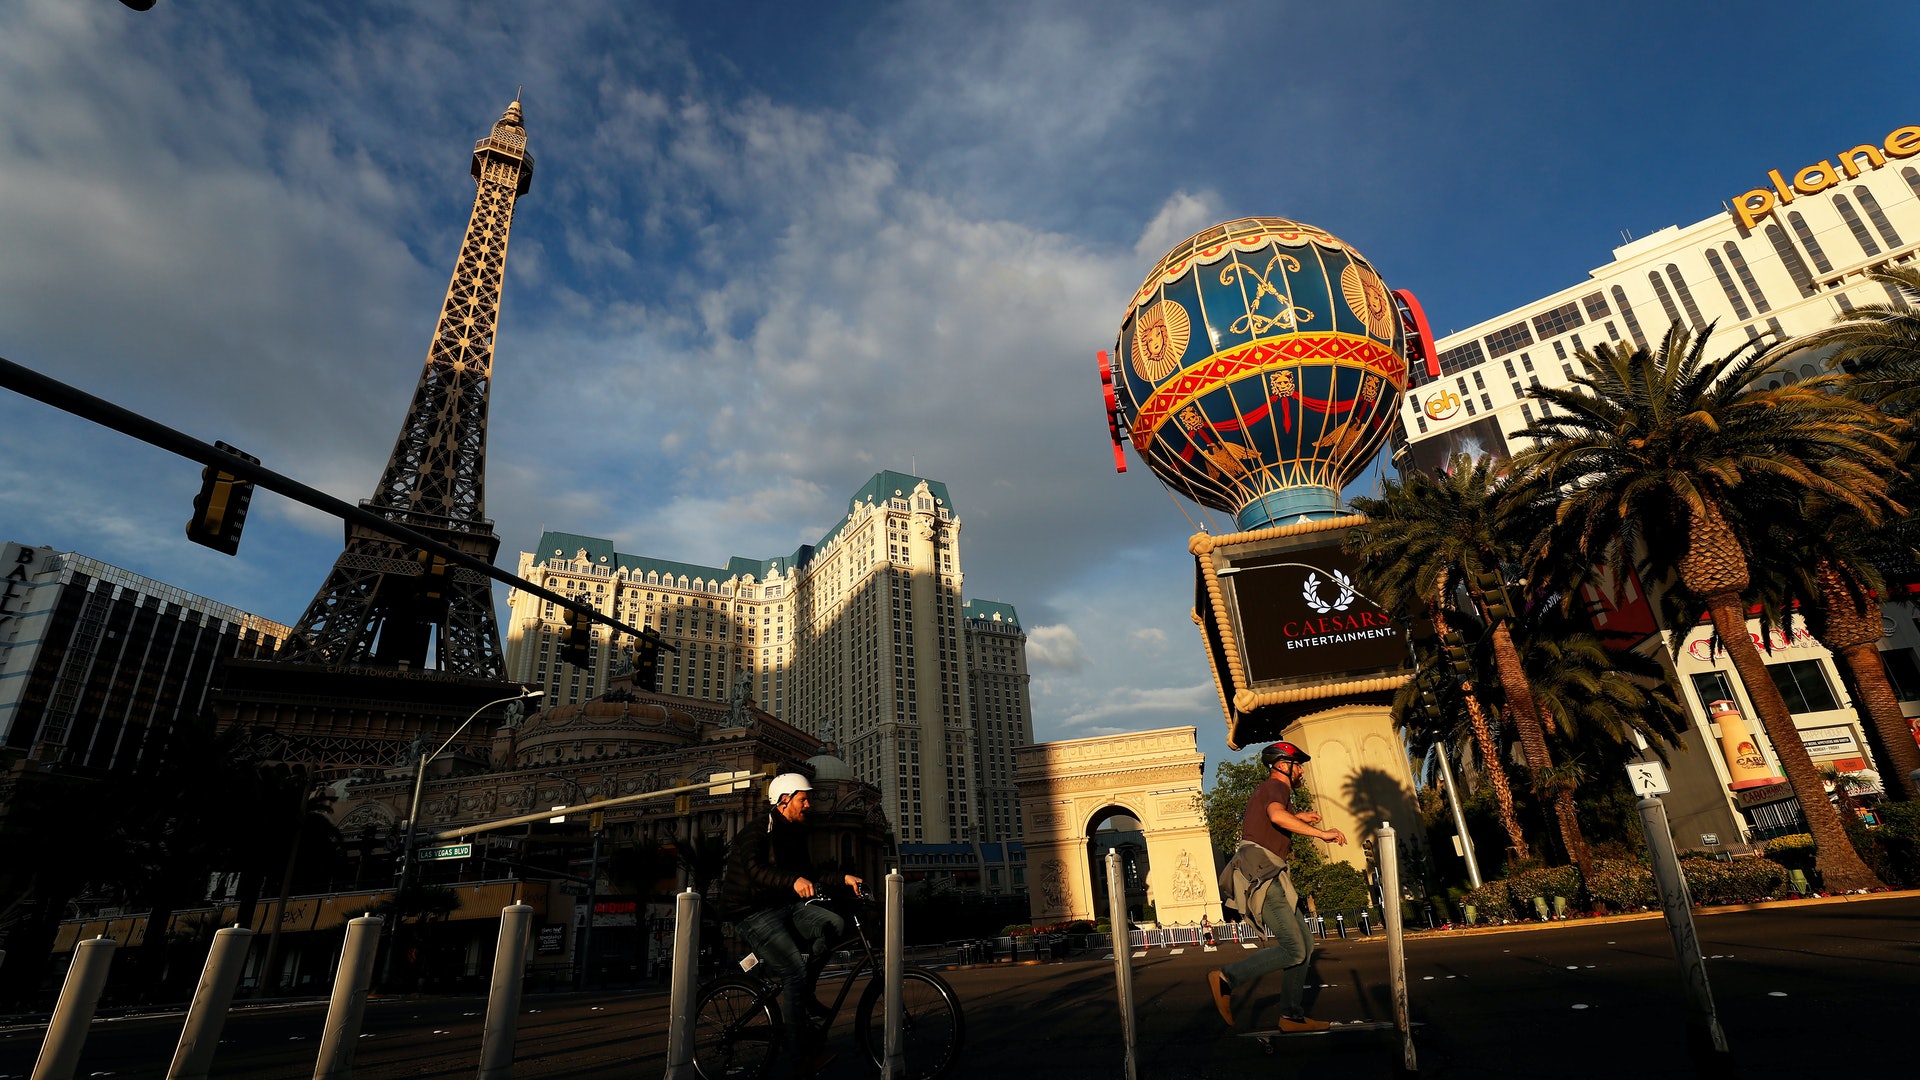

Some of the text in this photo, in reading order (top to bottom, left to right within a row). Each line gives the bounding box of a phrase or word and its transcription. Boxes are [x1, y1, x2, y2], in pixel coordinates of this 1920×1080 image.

[1427, 389, 1460, 418] ph
[1283, 612, 1389, 638] CAESARS
[1286, 627, 1393, 650] ENTERTAINMENT
[326, 665, 461, 684] EIFFEL TOWER RESTAURANT
[1742, 789, 1767, 804] CABO
[420, 847, 469, 859] LAS VEGAS BLVD
